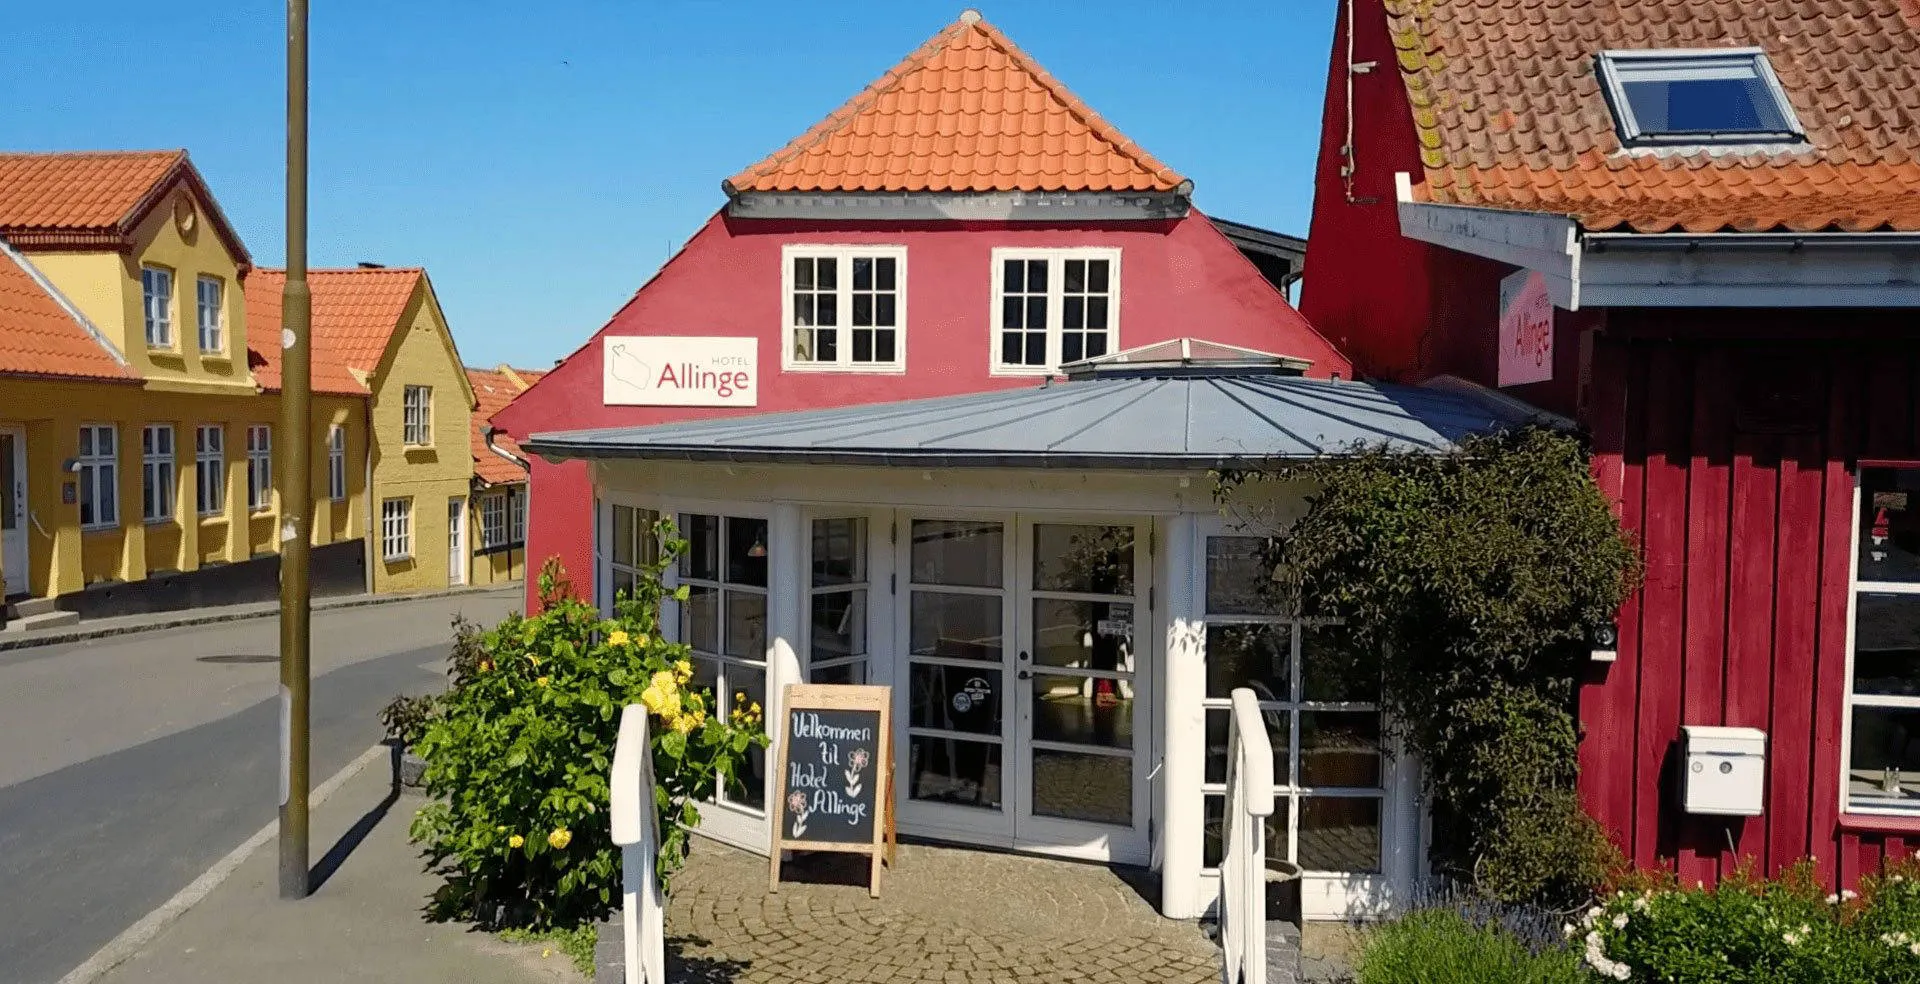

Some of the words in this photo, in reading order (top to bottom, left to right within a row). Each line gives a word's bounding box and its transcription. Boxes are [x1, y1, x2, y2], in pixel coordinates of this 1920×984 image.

[712, 357, 750, 366] HOTEL
[657, 363, 749, 398] Allinge
[792, 712, 871, 741] Velkommen
[819, 741, 840, 766] til
[790, 761, 828, 788] Hotel
[808, 790, 867, 826] Allinge
